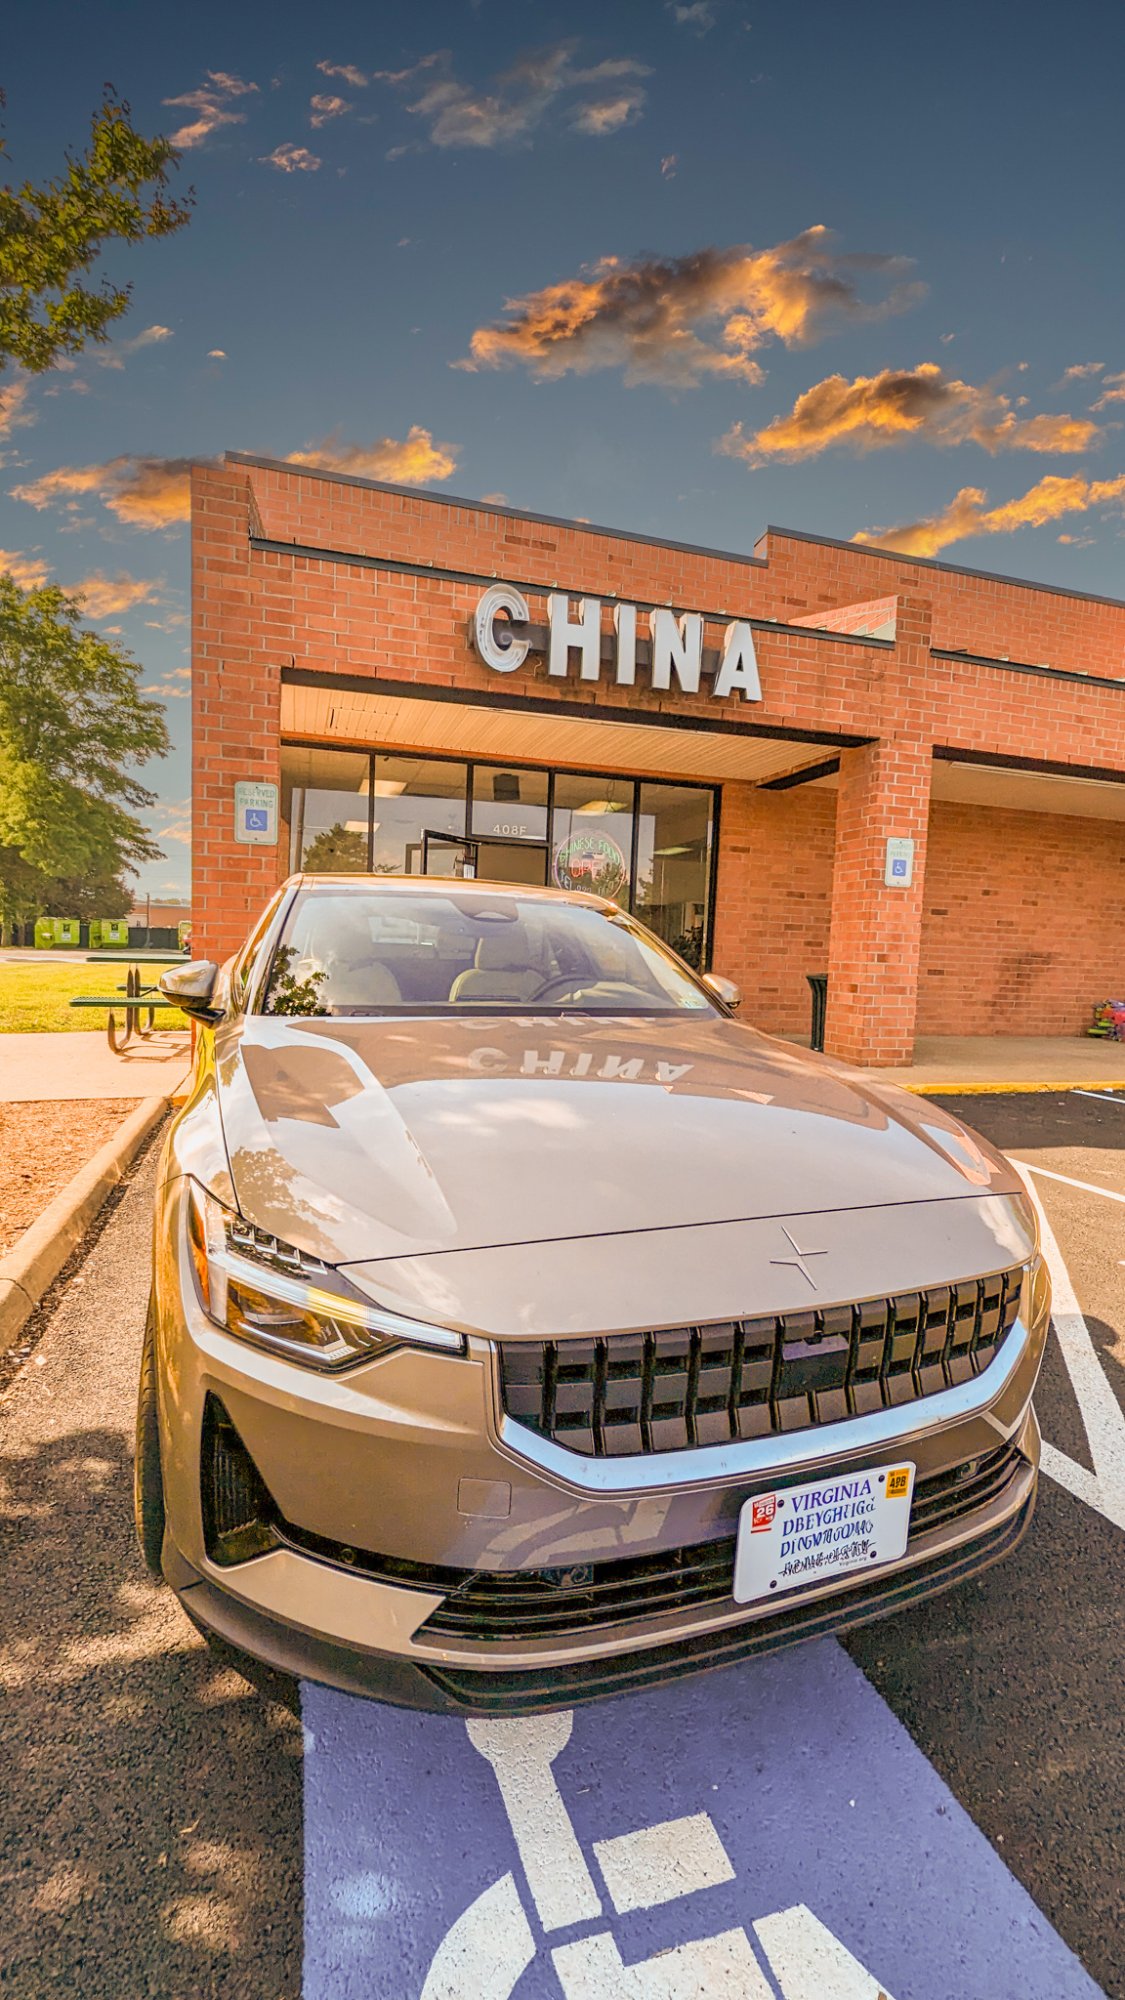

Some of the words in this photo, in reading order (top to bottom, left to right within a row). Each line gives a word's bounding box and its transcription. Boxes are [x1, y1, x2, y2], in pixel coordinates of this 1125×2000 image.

[474, 583, 763, 702] CHINA
[238, 787, 275, 798] RERVED
[493, 824, 527, 836] 408F
[791, 1478, 872, 1513] VIRGINIA
[756, 1503, 774, 1519] 26
